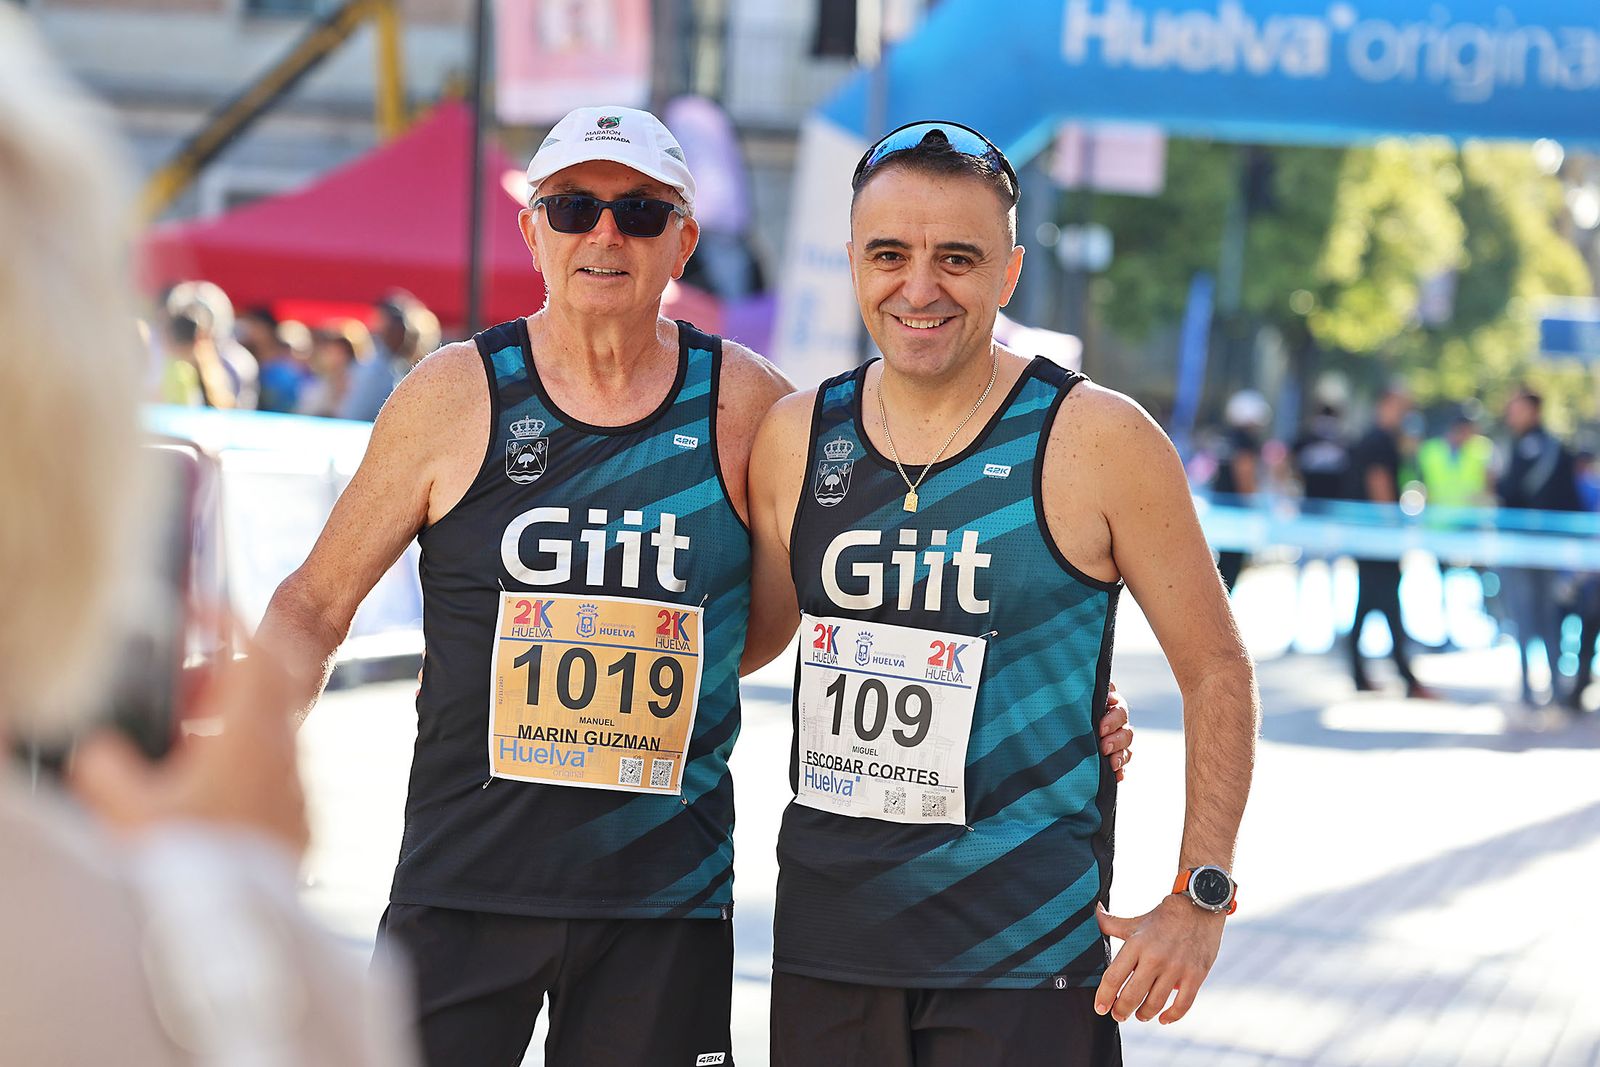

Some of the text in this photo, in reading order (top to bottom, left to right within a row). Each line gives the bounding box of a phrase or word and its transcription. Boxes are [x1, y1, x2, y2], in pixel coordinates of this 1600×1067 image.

[1062, 0, 1330, 77] Huelva
[595, 136, 631, 144] GRANADA
[675, 436, 696, 447] 42K
[985, 466, 1009, 477] 42K
[500, 507, 690, 593] Giit
[821, 529, 992, 614] Giit
[513, 599, 555, 629] 21K
[656, 609, 690, 642] 21K
[511, 627, 553, 639] HUELVA
[599, 627, 636, 638] HUELVA
[655, 637, 691, 652] HUELVA
[813, 623, 841, 656] 21K
[812, 651, 839, 665] HUELVA
[872, 655, 905, 668] HUELVA
[927, 639, 969, 674] 21K
[513, 644, 684, 719] 1019
[925, 668, 964, 684] HUELVA
[579, 716, 615, 727] MANUEL
[826, 673, 933, 748] 109
[518, 724, 661, 752] MARIN GUZMAN
[852, 745, 879, 757] MIGUEL
[500, 738, 585, 768] Huelva
[805, 765, 853, 797] Huelva
[806, 750, 940, 786] ESCOBAR CORTES
[699, 1054, 723, 1063] 42K
